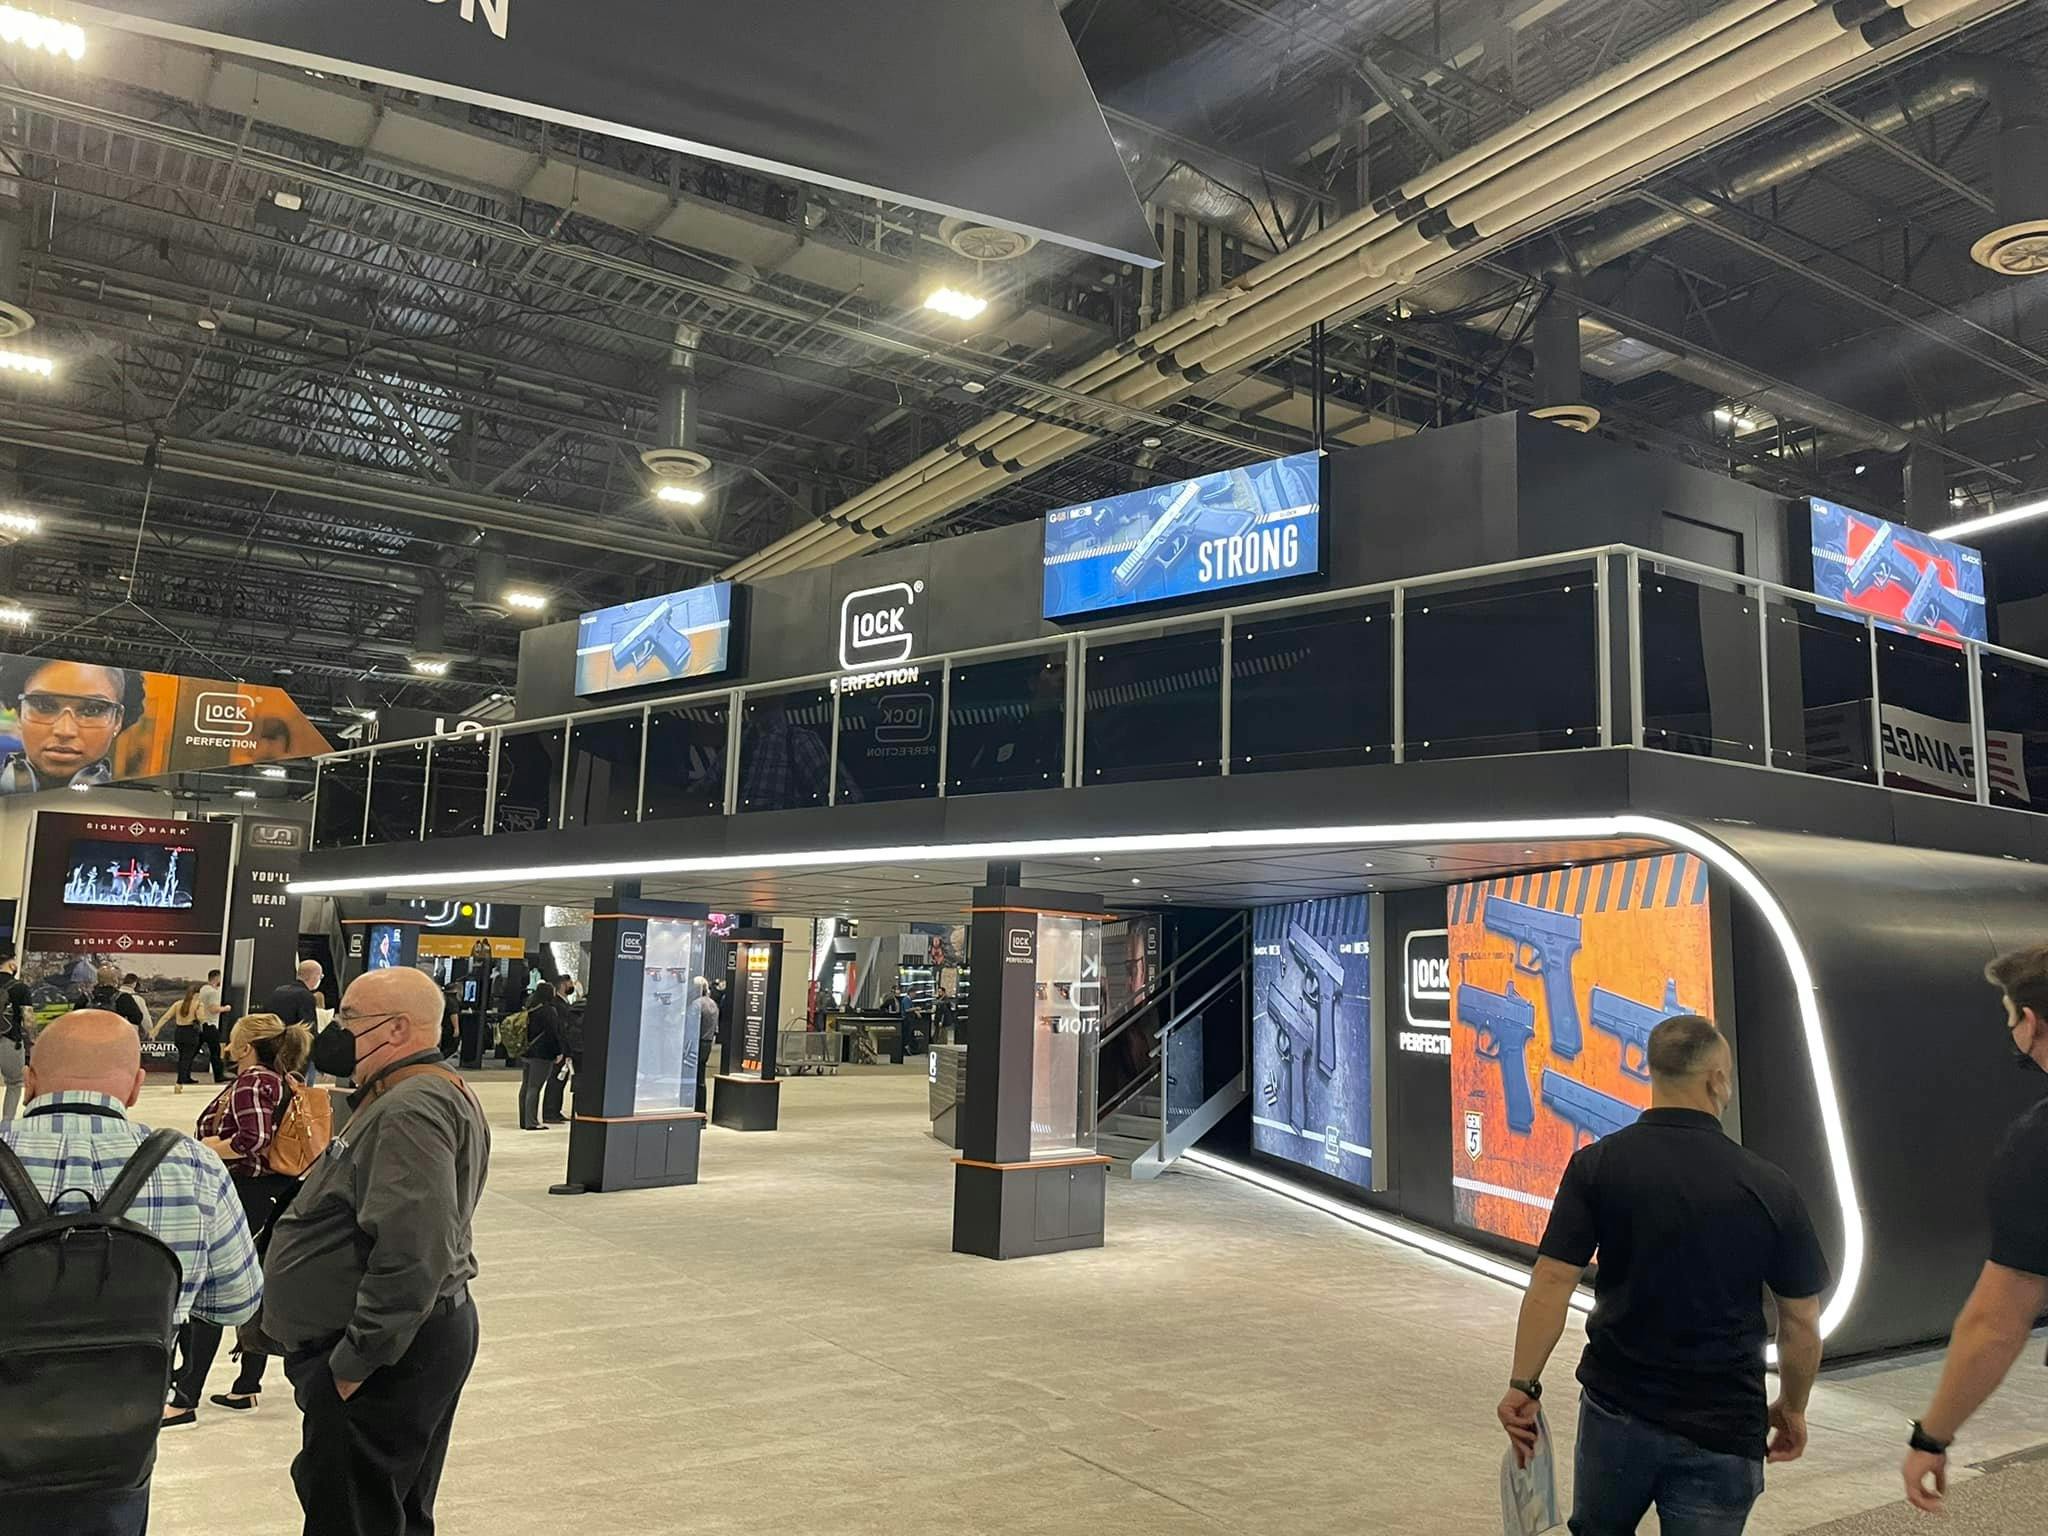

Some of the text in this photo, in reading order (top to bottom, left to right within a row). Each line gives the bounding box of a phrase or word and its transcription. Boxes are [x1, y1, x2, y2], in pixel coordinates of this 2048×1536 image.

[1198, 523, 1299, 583] STRONG
[186, 736, 257, 749] PERFECTION
[86, 822, 187, 836] SIGHT MARK
[251, 871, 291, 883] YOU'LL
[251, 894, 287, 905] WEAR
[258, 917, 275, 928] IT.
[73, 938, 175, 947] SIGHT MARK
[1469, 1131, 1479, 1153] 5
